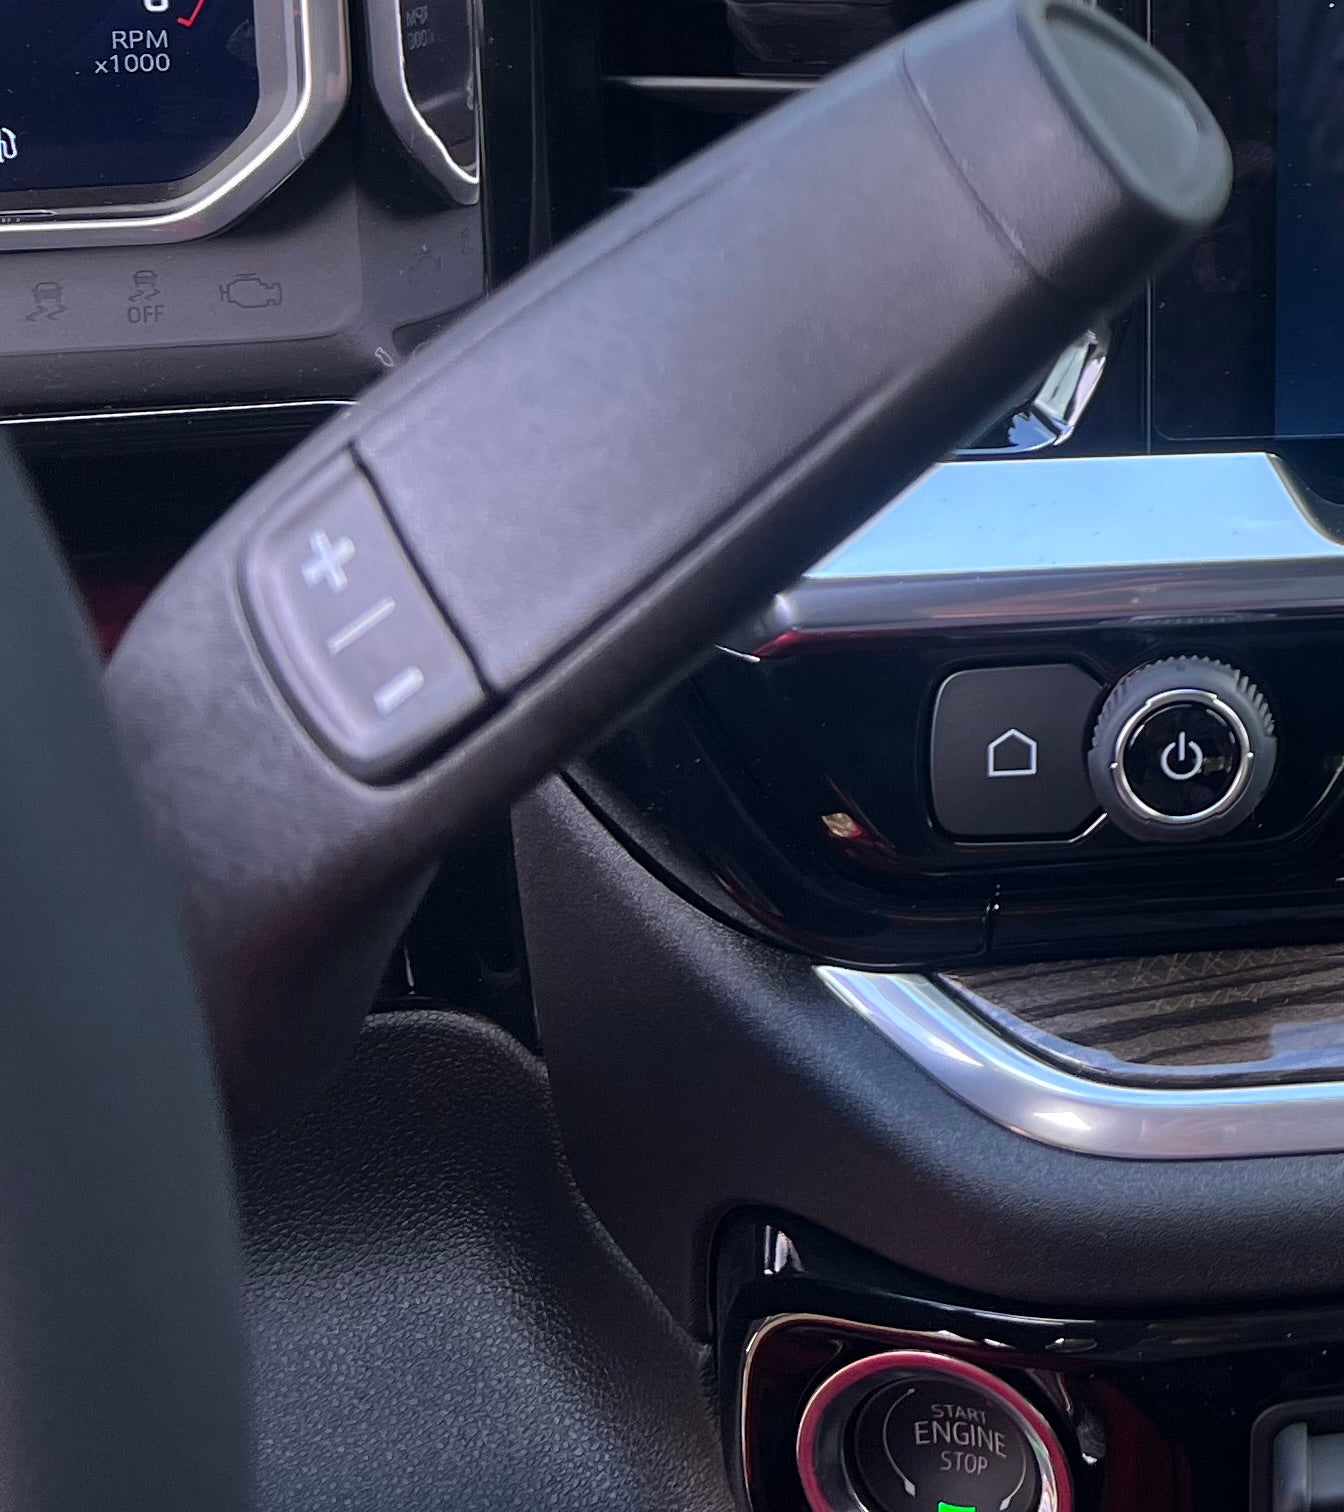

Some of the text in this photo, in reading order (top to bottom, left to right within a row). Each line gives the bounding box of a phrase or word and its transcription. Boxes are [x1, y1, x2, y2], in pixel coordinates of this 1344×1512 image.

[111, 29, 169, 49] RPM
[94, 53, 171, 74] x1000
[127, 304, 165, 324] OFF
[930, 1403, 986, 1425] START
[914, 1420, 1007, 1461] ENGINE
[940, 1450, 988, 1475] STOP
